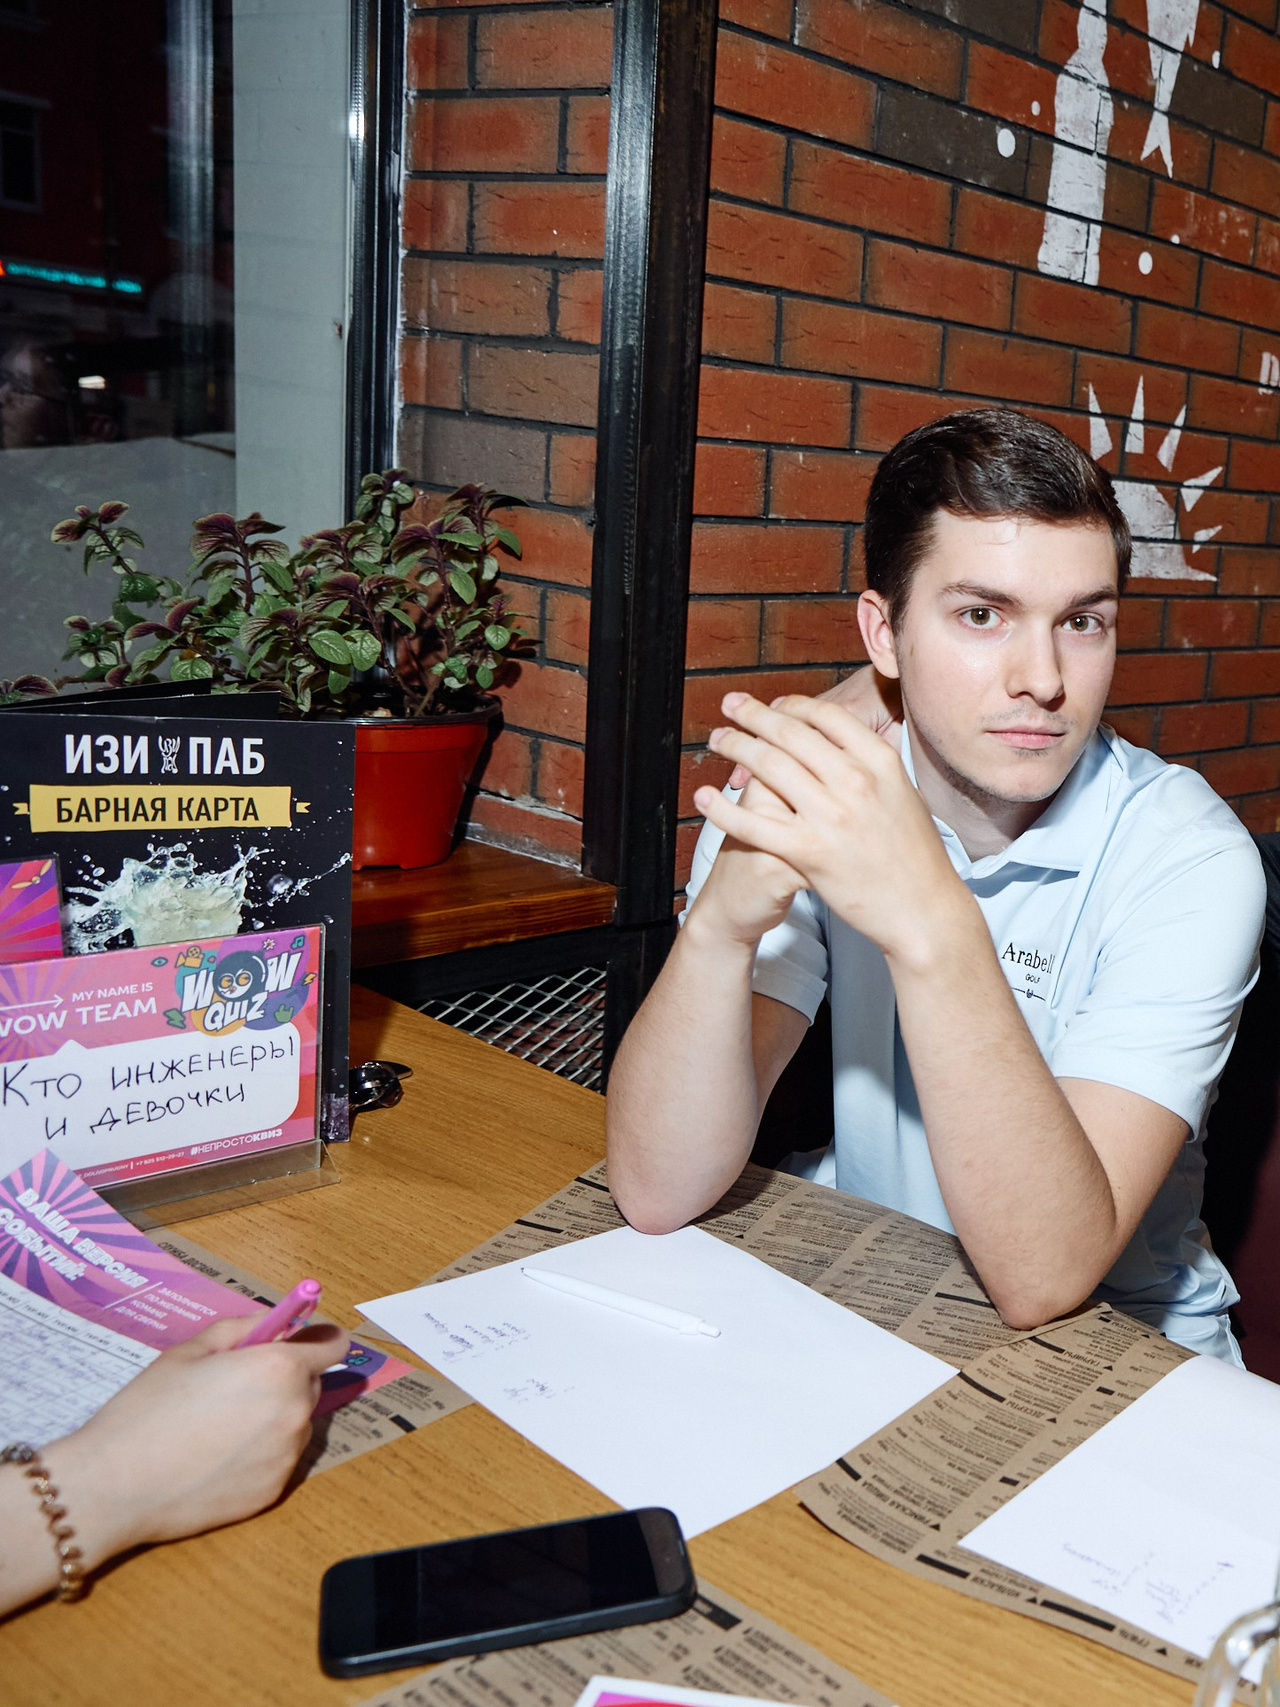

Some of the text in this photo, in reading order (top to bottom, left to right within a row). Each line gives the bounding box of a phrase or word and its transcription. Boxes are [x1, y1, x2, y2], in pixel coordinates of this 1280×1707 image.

[64, 734, 266, 775] ИЗИ ПАБ
[56, 797, 260, 823] БАРНАЯ КАРТА
[71, 982, 154, 1002] MY NAME IS
[75, 996, 157, 1026] TEAM
[203, 991, 269, 1032] QUIZ
[2, 1036, 294, 1107] Кто ИНЖЕНЕРЫ
[89, 1083, 246, 1136] ДЕВОЧКИ
[190, 1128, 283, 1157] #НЕПРОСТОКВИЗ
[16, 1187, 149, 1289] ВАША ВЕРСИЯ
[1065, 1350, 1099, 1366] ГАРНИРЫ
[1007, 1398, 1044, 1419] ДЕСЕРТЫ
